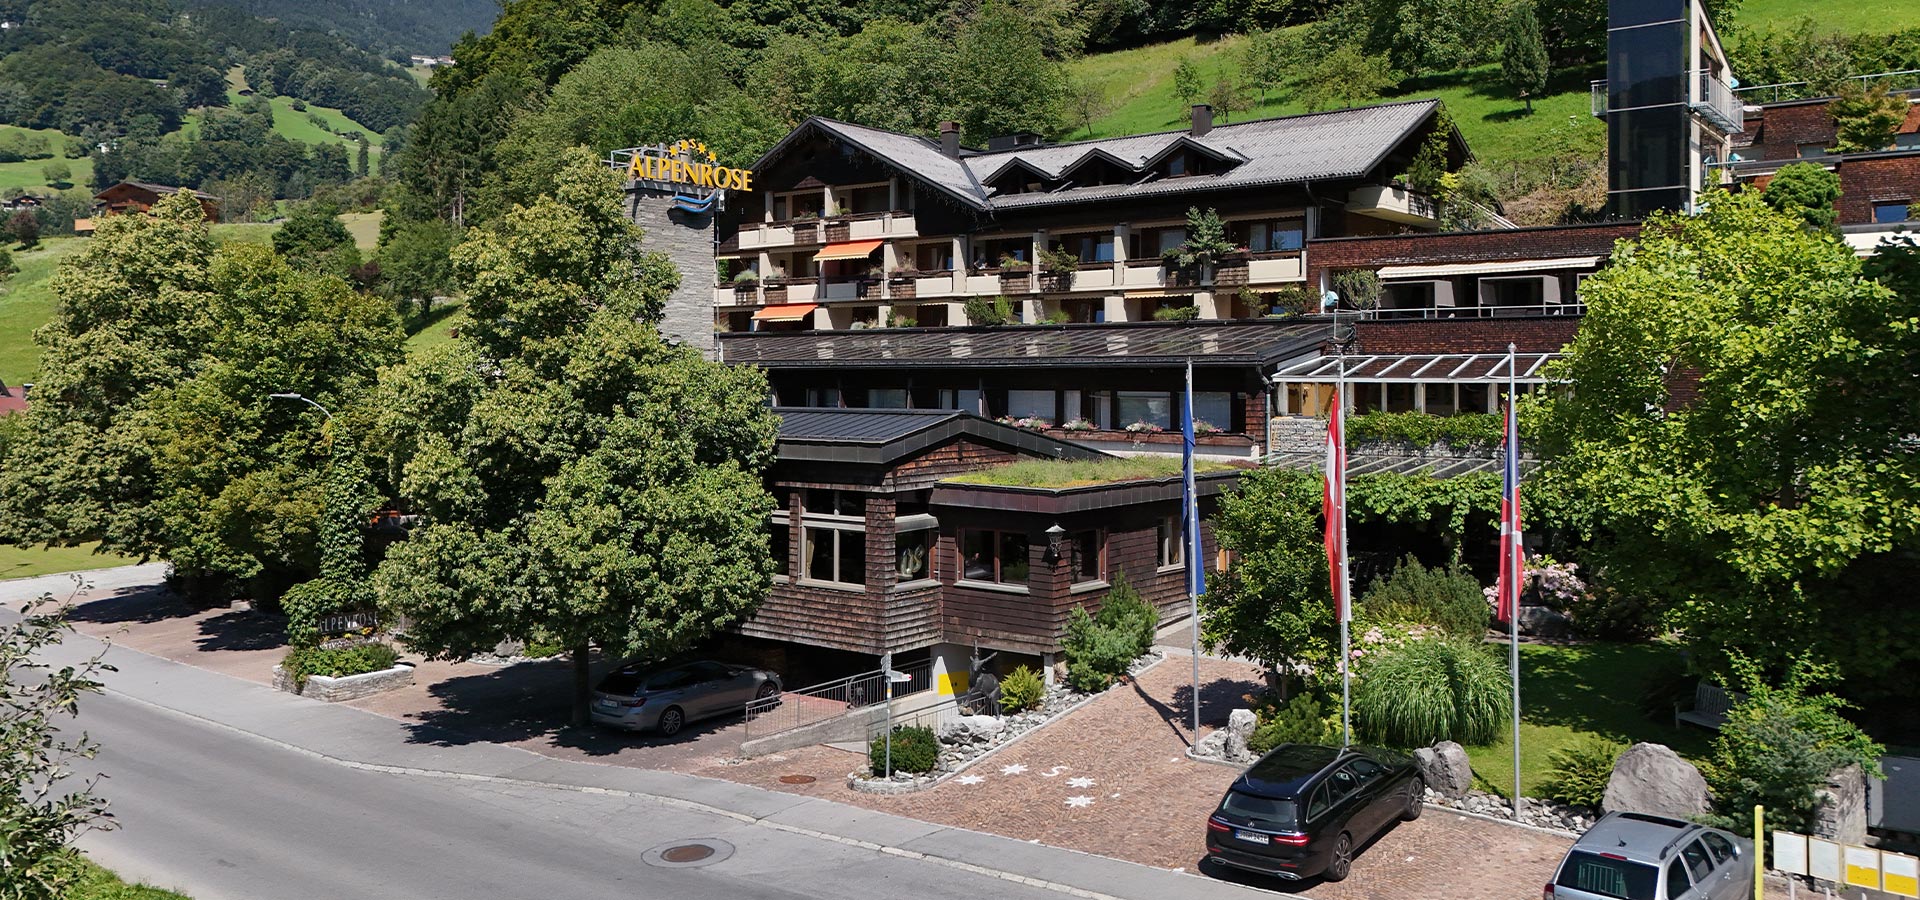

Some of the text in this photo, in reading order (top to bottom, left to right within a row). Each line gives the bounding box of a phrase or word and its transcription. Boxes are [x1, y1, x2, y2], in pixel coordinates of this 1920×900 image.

[688, 138, 696, 149] S
[630, 155, 753, 192] ALPENROSE
[317, 611, 379, 633] ALPENROSE
[1041, 765, 1069, 777] S
